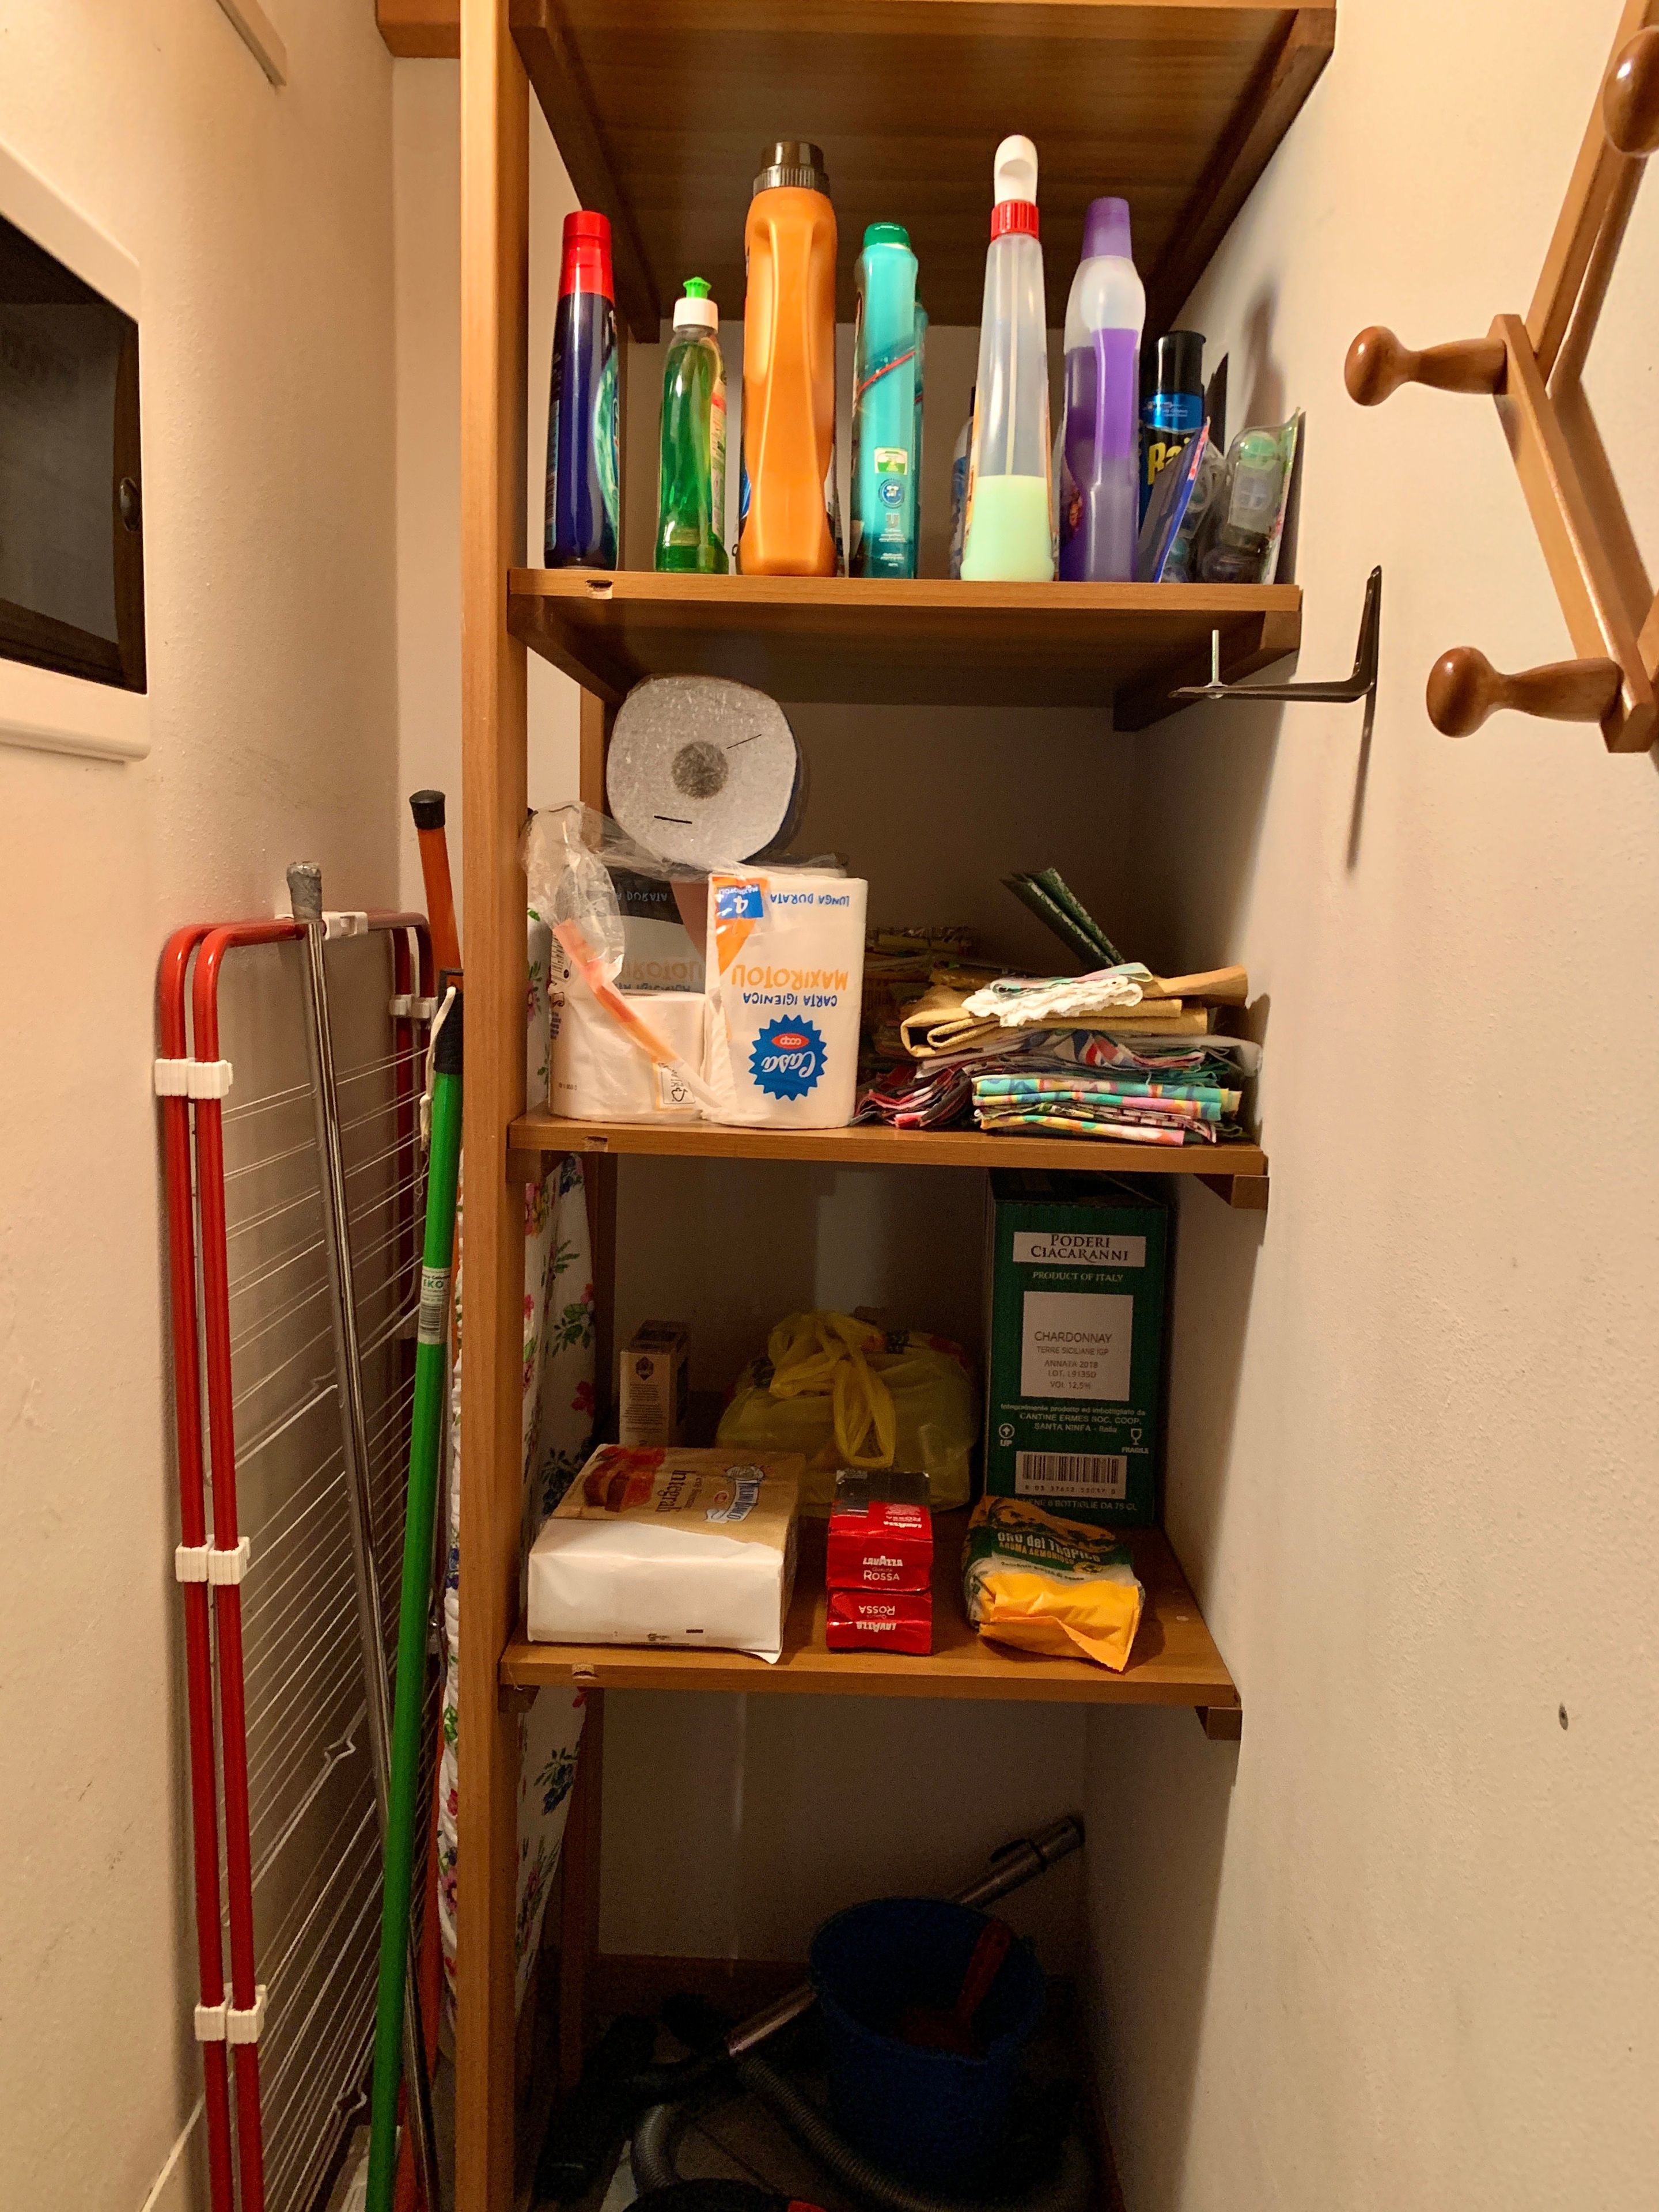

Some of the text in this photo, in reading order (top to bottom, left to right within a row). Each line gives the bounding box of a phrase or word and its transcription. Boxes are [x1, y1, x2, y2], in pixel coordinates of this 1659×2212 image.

[734, 896, 749, 914] 4
[770, 893, 850, 907] LUNGA DURATA
[731, 964, 849, 991] MAXIROTOLI
[743, 993, 838, 1007] CARTA IGIENICA
[780, 1036, 801, 1046] coop
[760, 1051, 816, 1078] Casa
[1051, 1234, 1110, 1248] PODERI
[1031, 1245, 1128, 1263] CIACARANNI
[1032, 1271, 1124, 1282] PRODUCT OF ITALY
[1034, 1331, 1112, 1343] CHARDONNAY
[1062, 1347, 1095, 1355] SICILIANE
[1079, 1361, 1099, 1369] 2018
[1019, 1413, 1056, 1421] CANTINE
[1033, 1423, 1063, 1431] SANTA
[1065, 1423, 1091, 1431] NINFA
[1000, 1439, 1013, 1447] UP
[1121, 1446, 1149, 1455] FRAGILE
[1055, 1500, 1099, 1509] BOTTIGLIE
[1027, 1535, 1046, 1549] del
[862, 1555, 903, 1567] LAVAZZA
[863, 1570, 900, 1581] ROSSA
[858, 1605, 895, 1616] ROSSA
